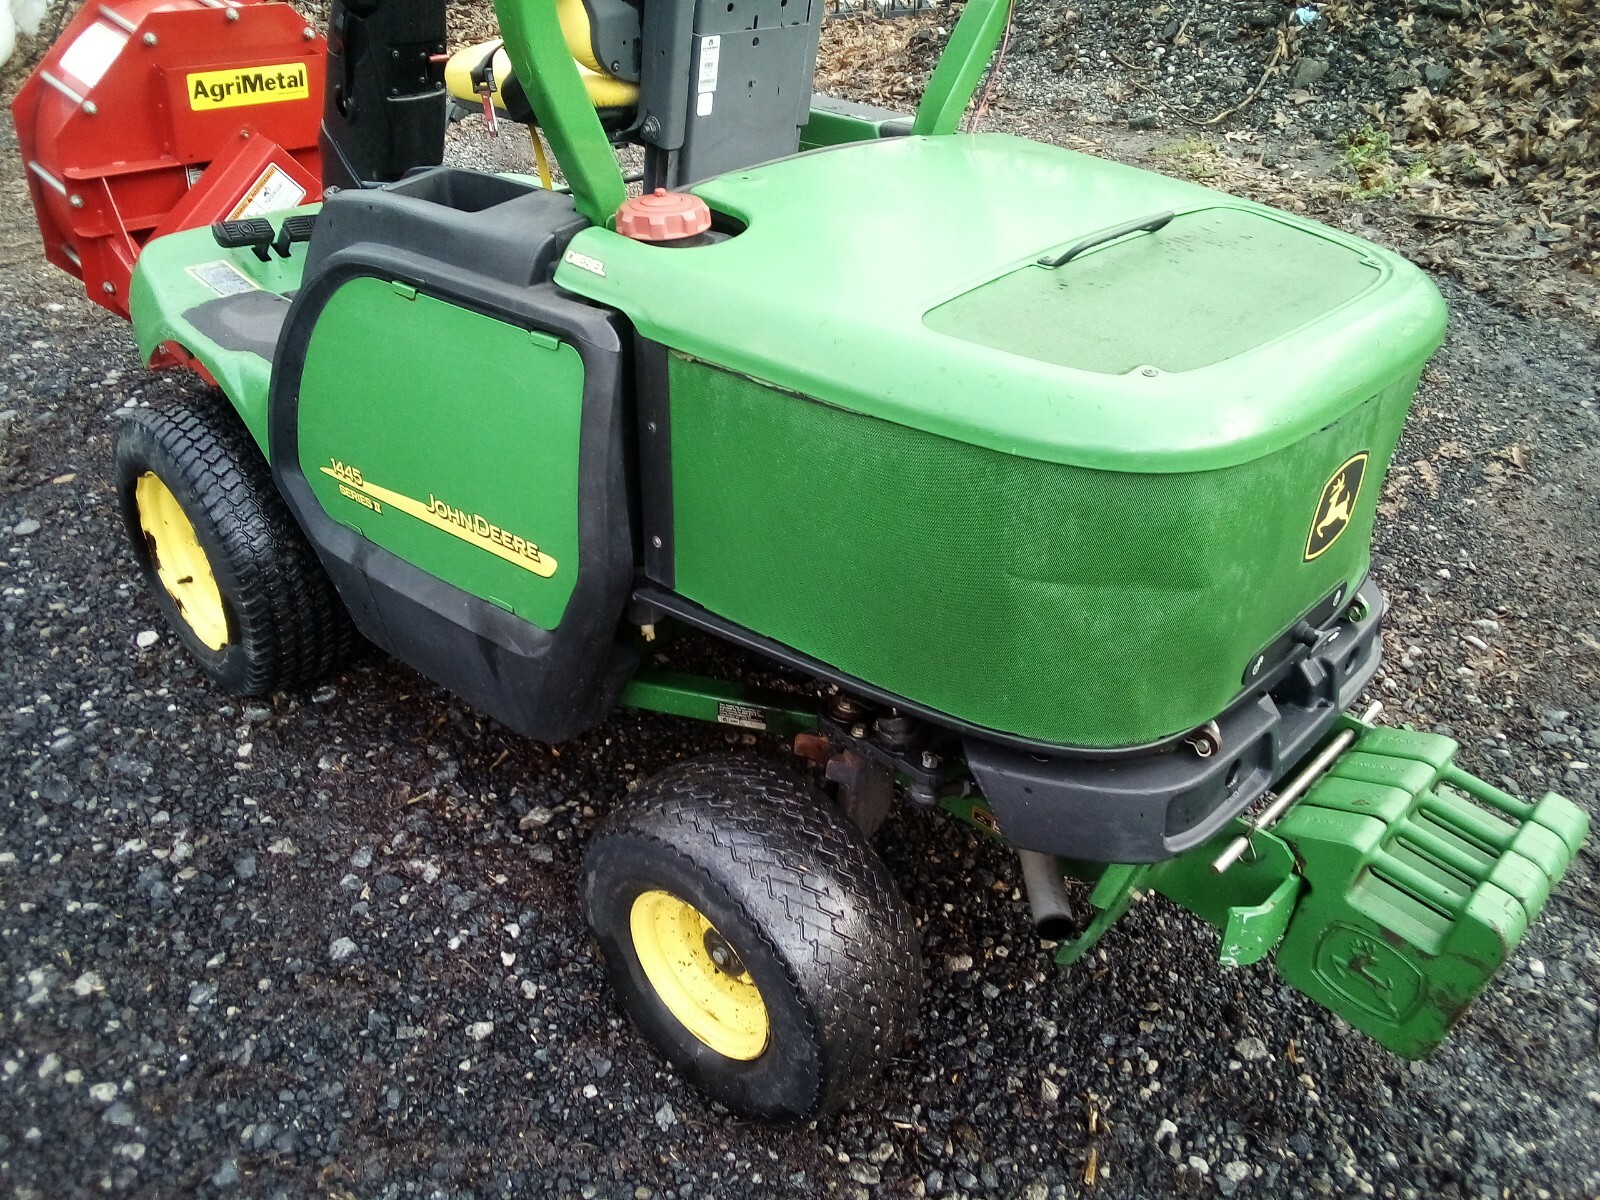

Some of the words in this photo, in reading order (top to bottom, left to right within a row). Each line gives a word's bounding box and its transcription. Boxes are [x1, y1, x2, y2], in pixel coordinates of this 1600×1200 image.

[193, 69, 305, 102] AgriMetal
[565, 249, 606, 278] DIESEL
[330, 457, 363, 487] 1445
[338, 483, 374, 511] SERIES
